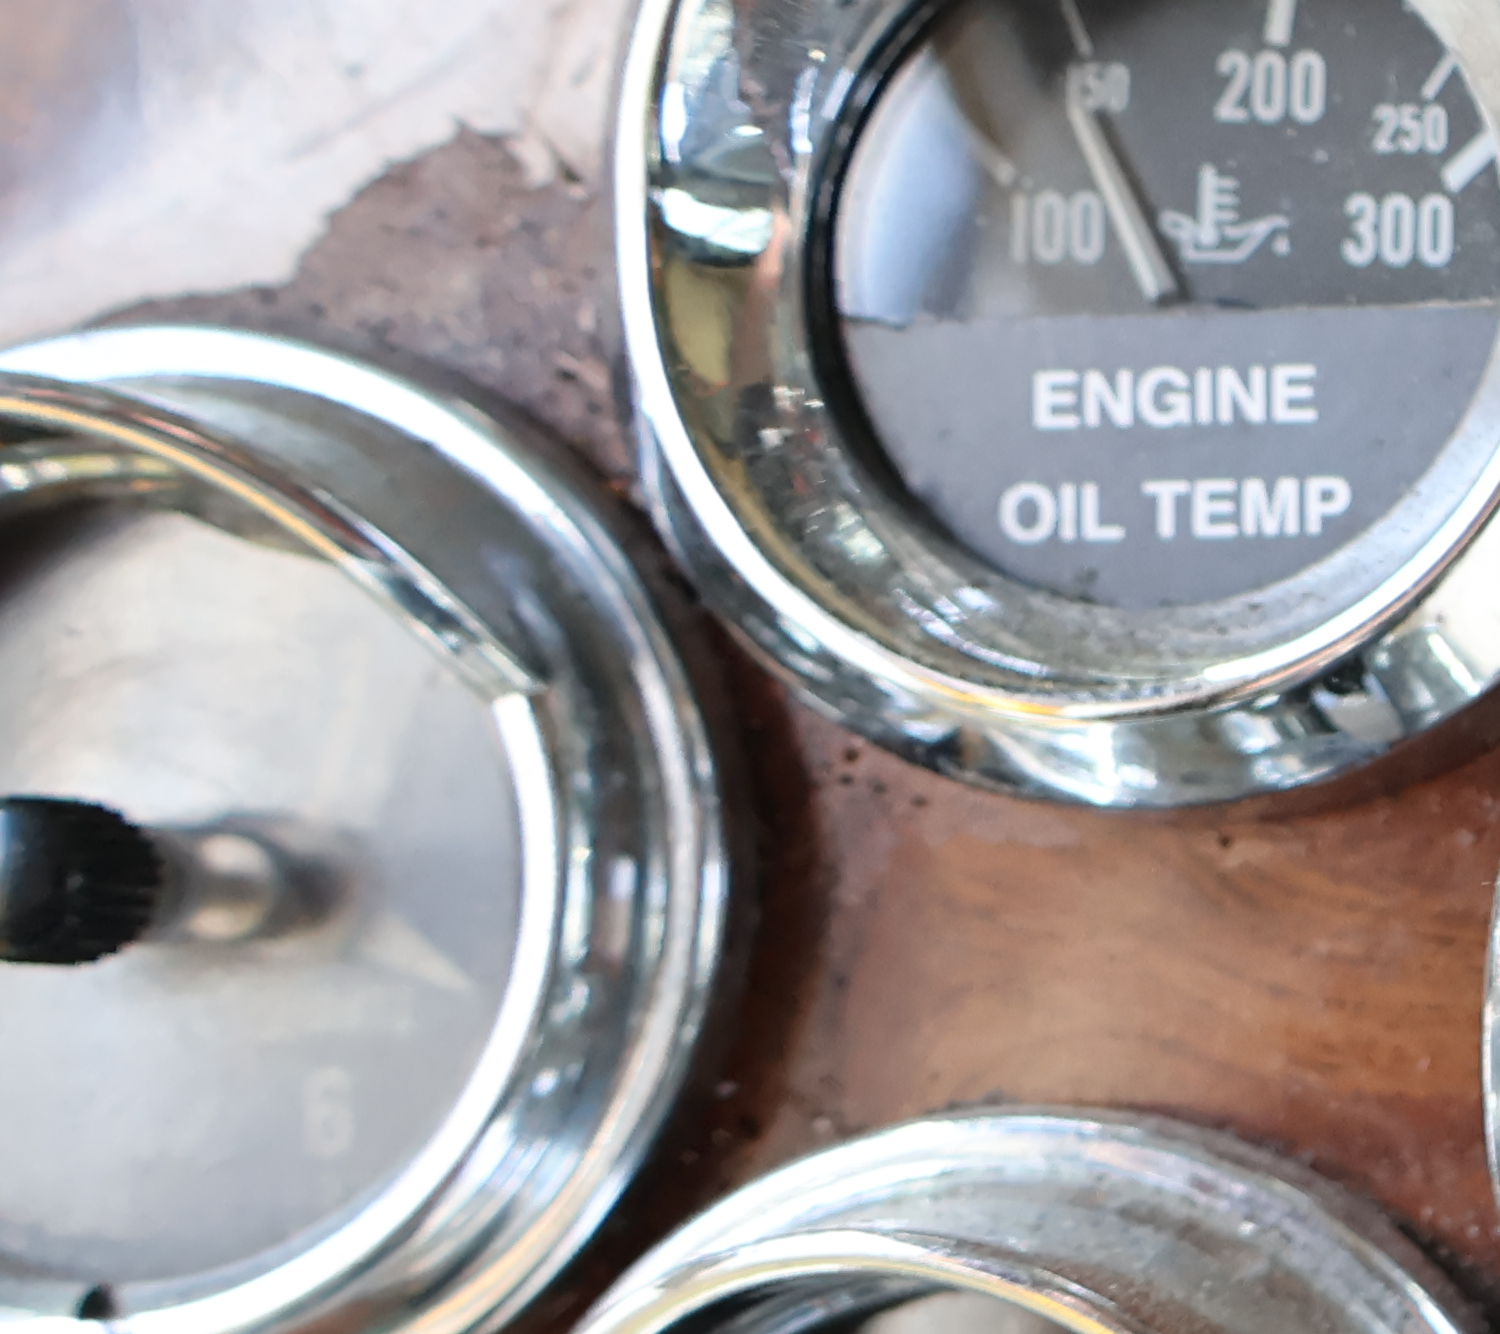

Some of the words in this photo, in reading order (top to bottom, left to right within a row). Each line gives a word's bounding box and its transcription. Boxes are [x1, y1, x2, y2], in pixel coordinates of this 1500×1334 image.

[1215, 51, 1328, 123] 200
[1372, 105, 1450, 155] 250
[1009, 190, 1106, 264] 100
[1341, 195, 1455, 268] 300
[1032, 365, 1319, 429] ENGINE
[1000, 483, 1124, 545] OIL
[1141, 476, 1353, 538] TEMP
